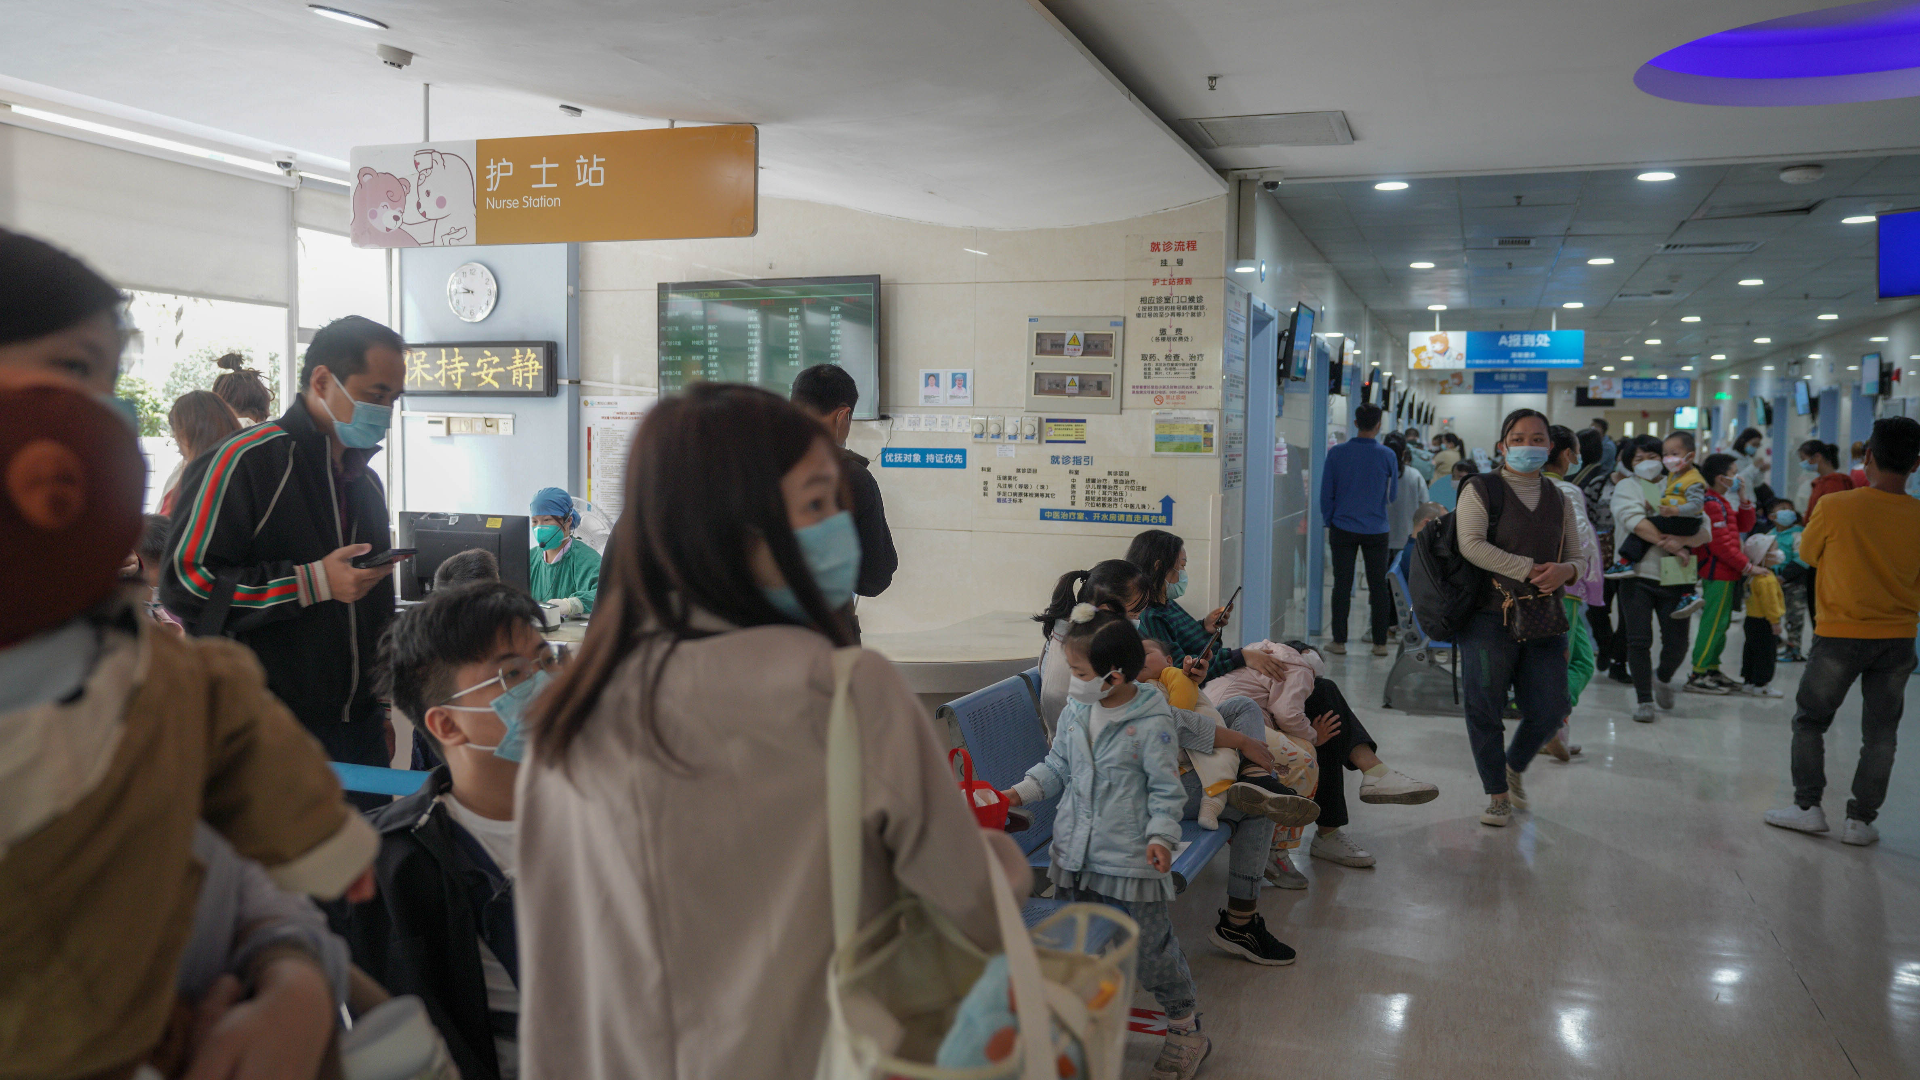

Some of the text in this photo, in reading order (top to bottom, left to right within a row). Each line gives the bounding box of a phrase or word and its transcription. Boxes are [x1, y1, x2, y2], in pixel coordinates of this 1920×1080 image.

[486, 154, 605, 191] 护士站
[486, 195, 560, 209] Nurse Station
[1150, 240, 1197, 252] 就诊流程
[1152, 277, 1193, 286] 护士站报到
[1498, 334, 1551, 347] A报到处
[404, 348, 543, 390] 保持安静
[885, 453, 963, 464] 优抚对象 持证优先
[1050, 455, 1094, 466] 就诊指引
